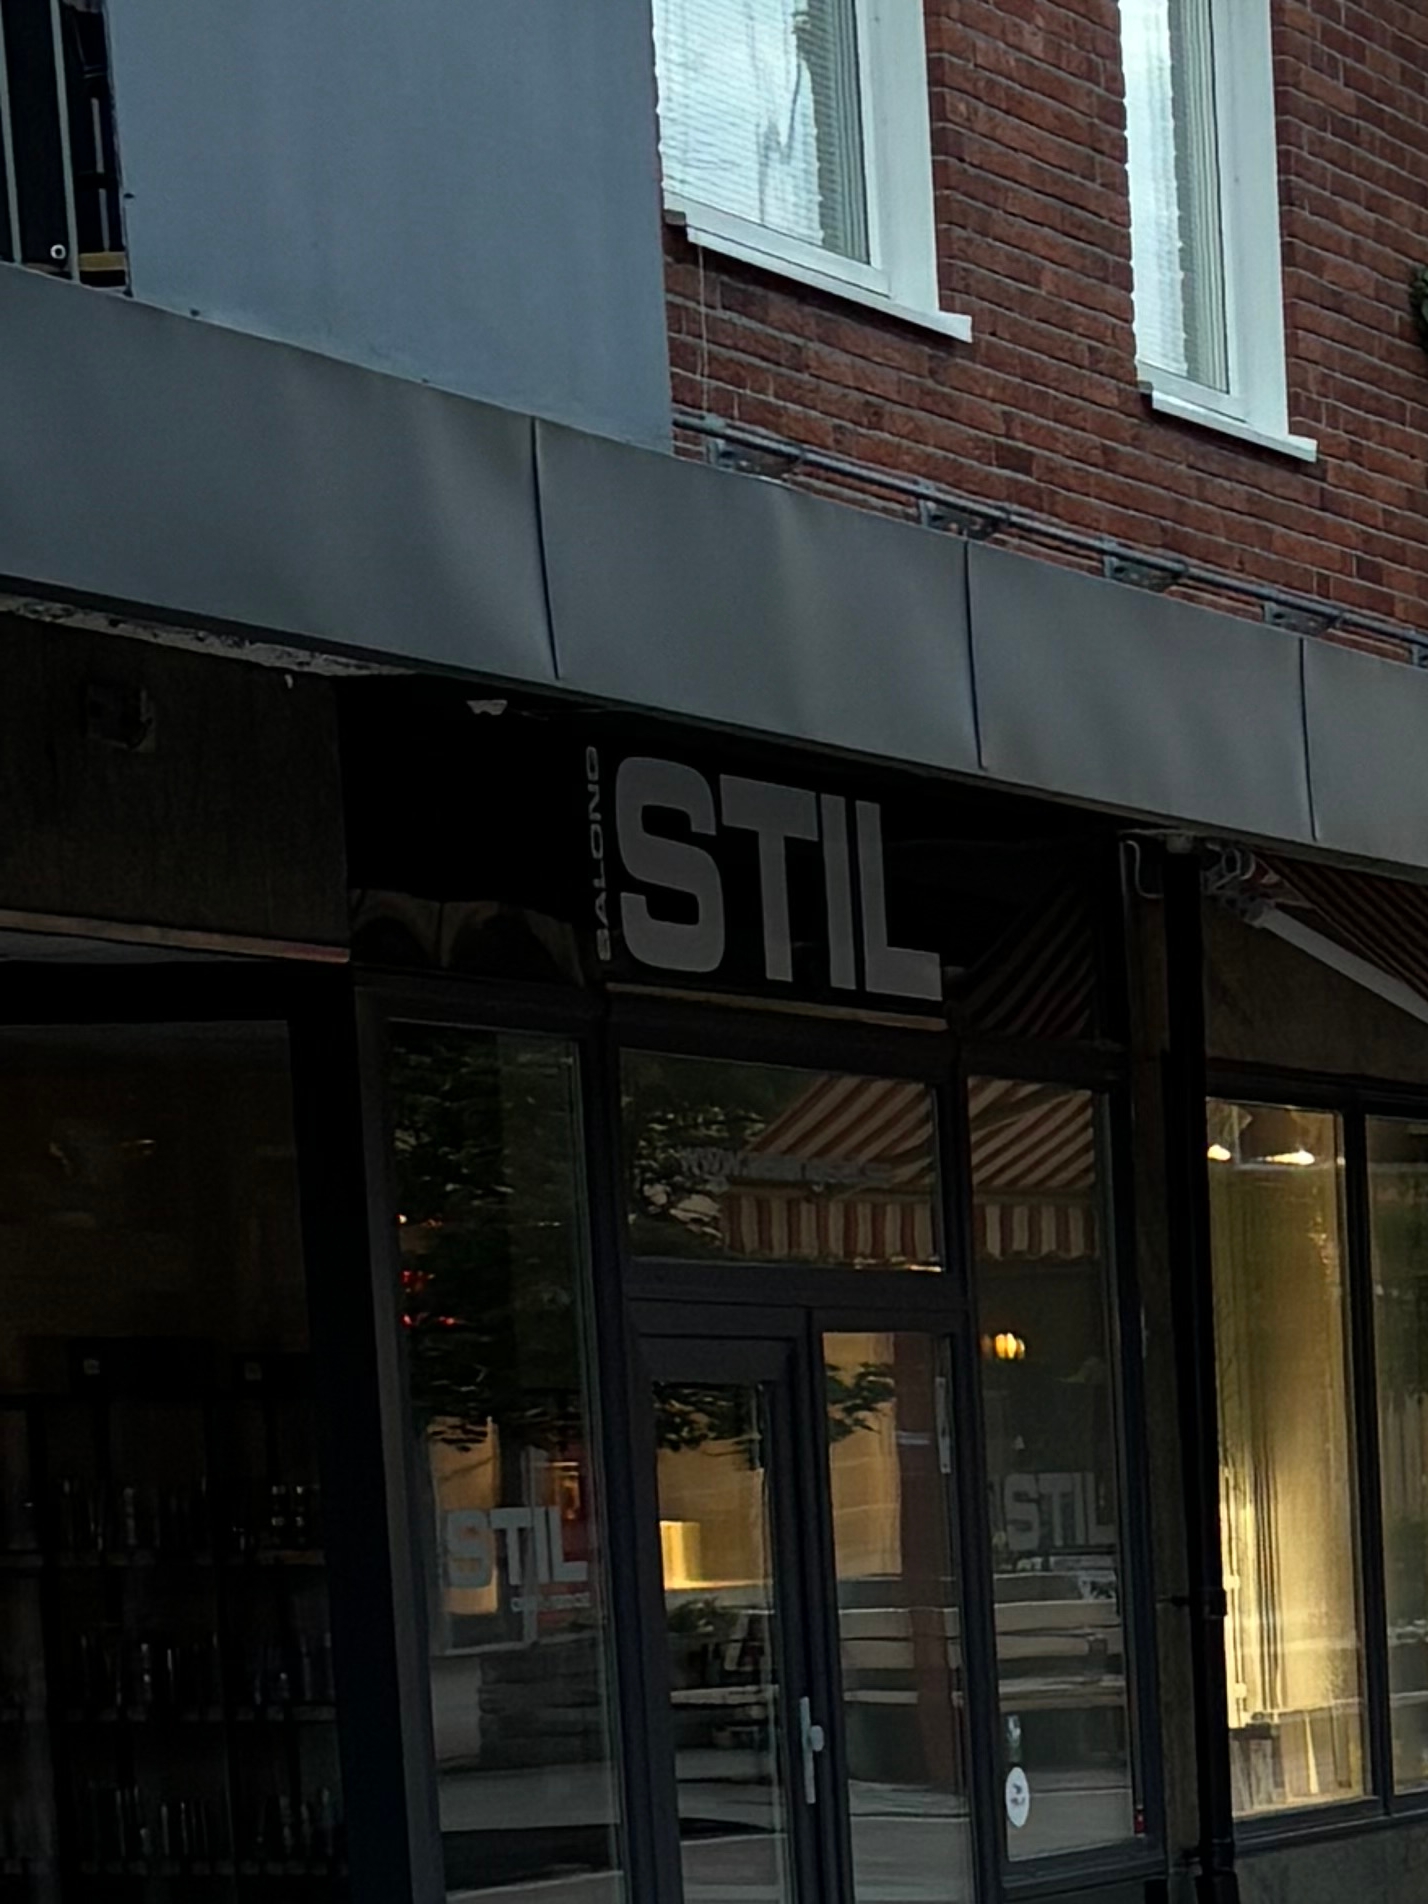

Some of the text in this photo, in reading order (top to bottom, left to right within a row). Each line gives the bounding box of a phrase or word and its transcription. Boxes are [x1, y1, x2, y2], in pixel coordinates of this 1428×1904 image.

[585, 745, 612, 961] SALONG
[615, 756, 943, 1001] STIL
[447, 1505, 589, 1589] STIL
[1003, 1471, 1117, 1552] STIL
